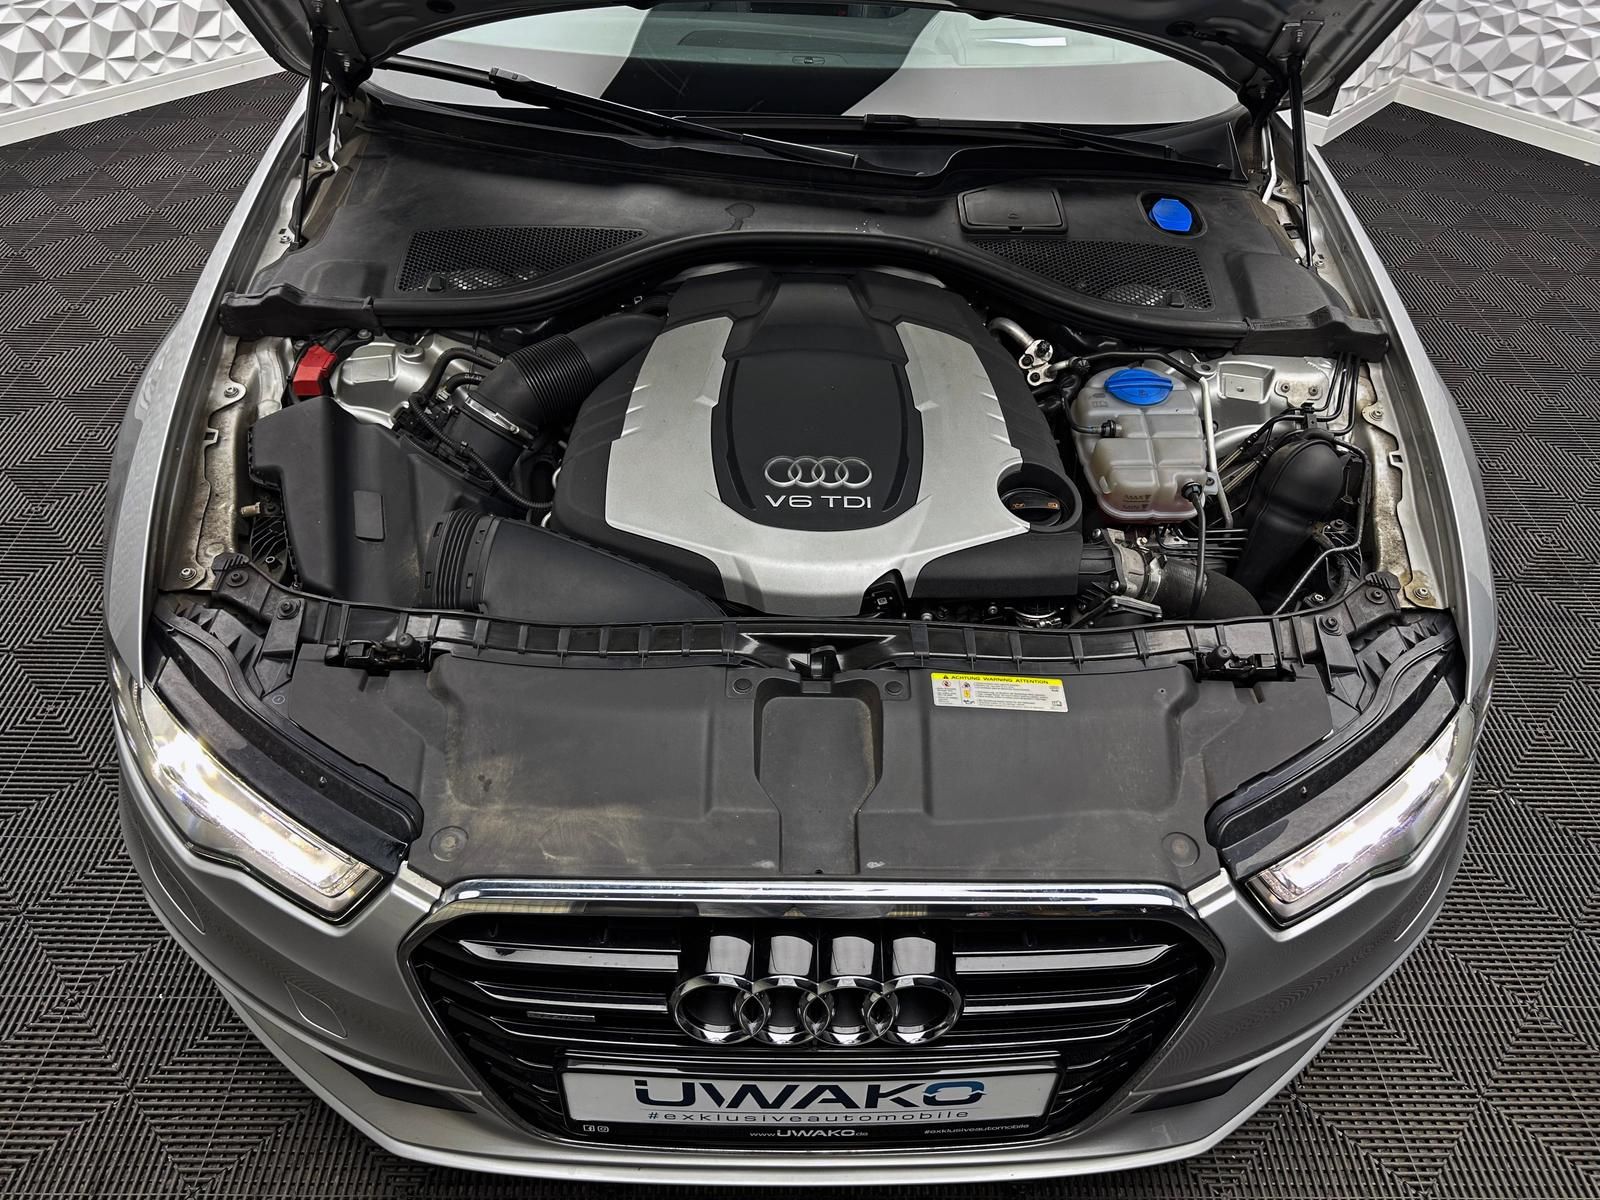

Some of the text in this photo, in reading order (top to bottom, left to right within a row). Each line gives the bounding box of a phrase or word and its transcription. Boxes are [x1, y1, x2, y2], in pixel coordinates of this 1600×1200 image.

[764, 495, 872, 508] V6 TDI
[634, 1080, 986, 1109] UWAKO
[648, 1110, 969, 1122] #exklusiveautomobile
[924, 1123, 1030, 1135] #exklusiveautomobile
